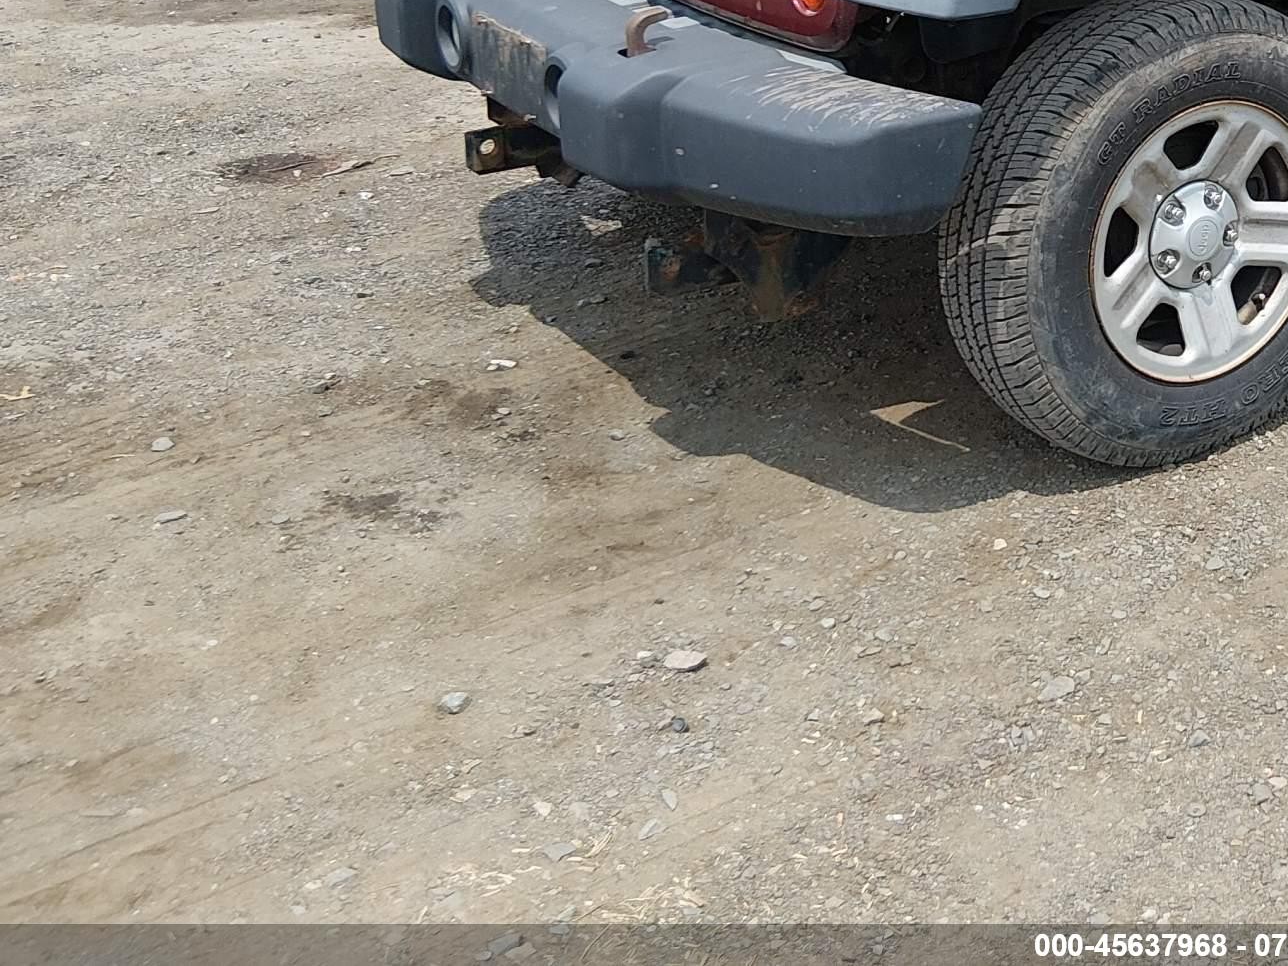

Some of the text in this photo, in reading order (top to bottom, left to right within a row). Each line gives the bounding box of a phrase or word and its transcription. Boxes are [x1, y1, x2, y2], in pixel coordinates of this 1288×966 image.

[1096, 61, 1241, 166] GT RADIAL
[1159, 399, 1227, 427] HT2
